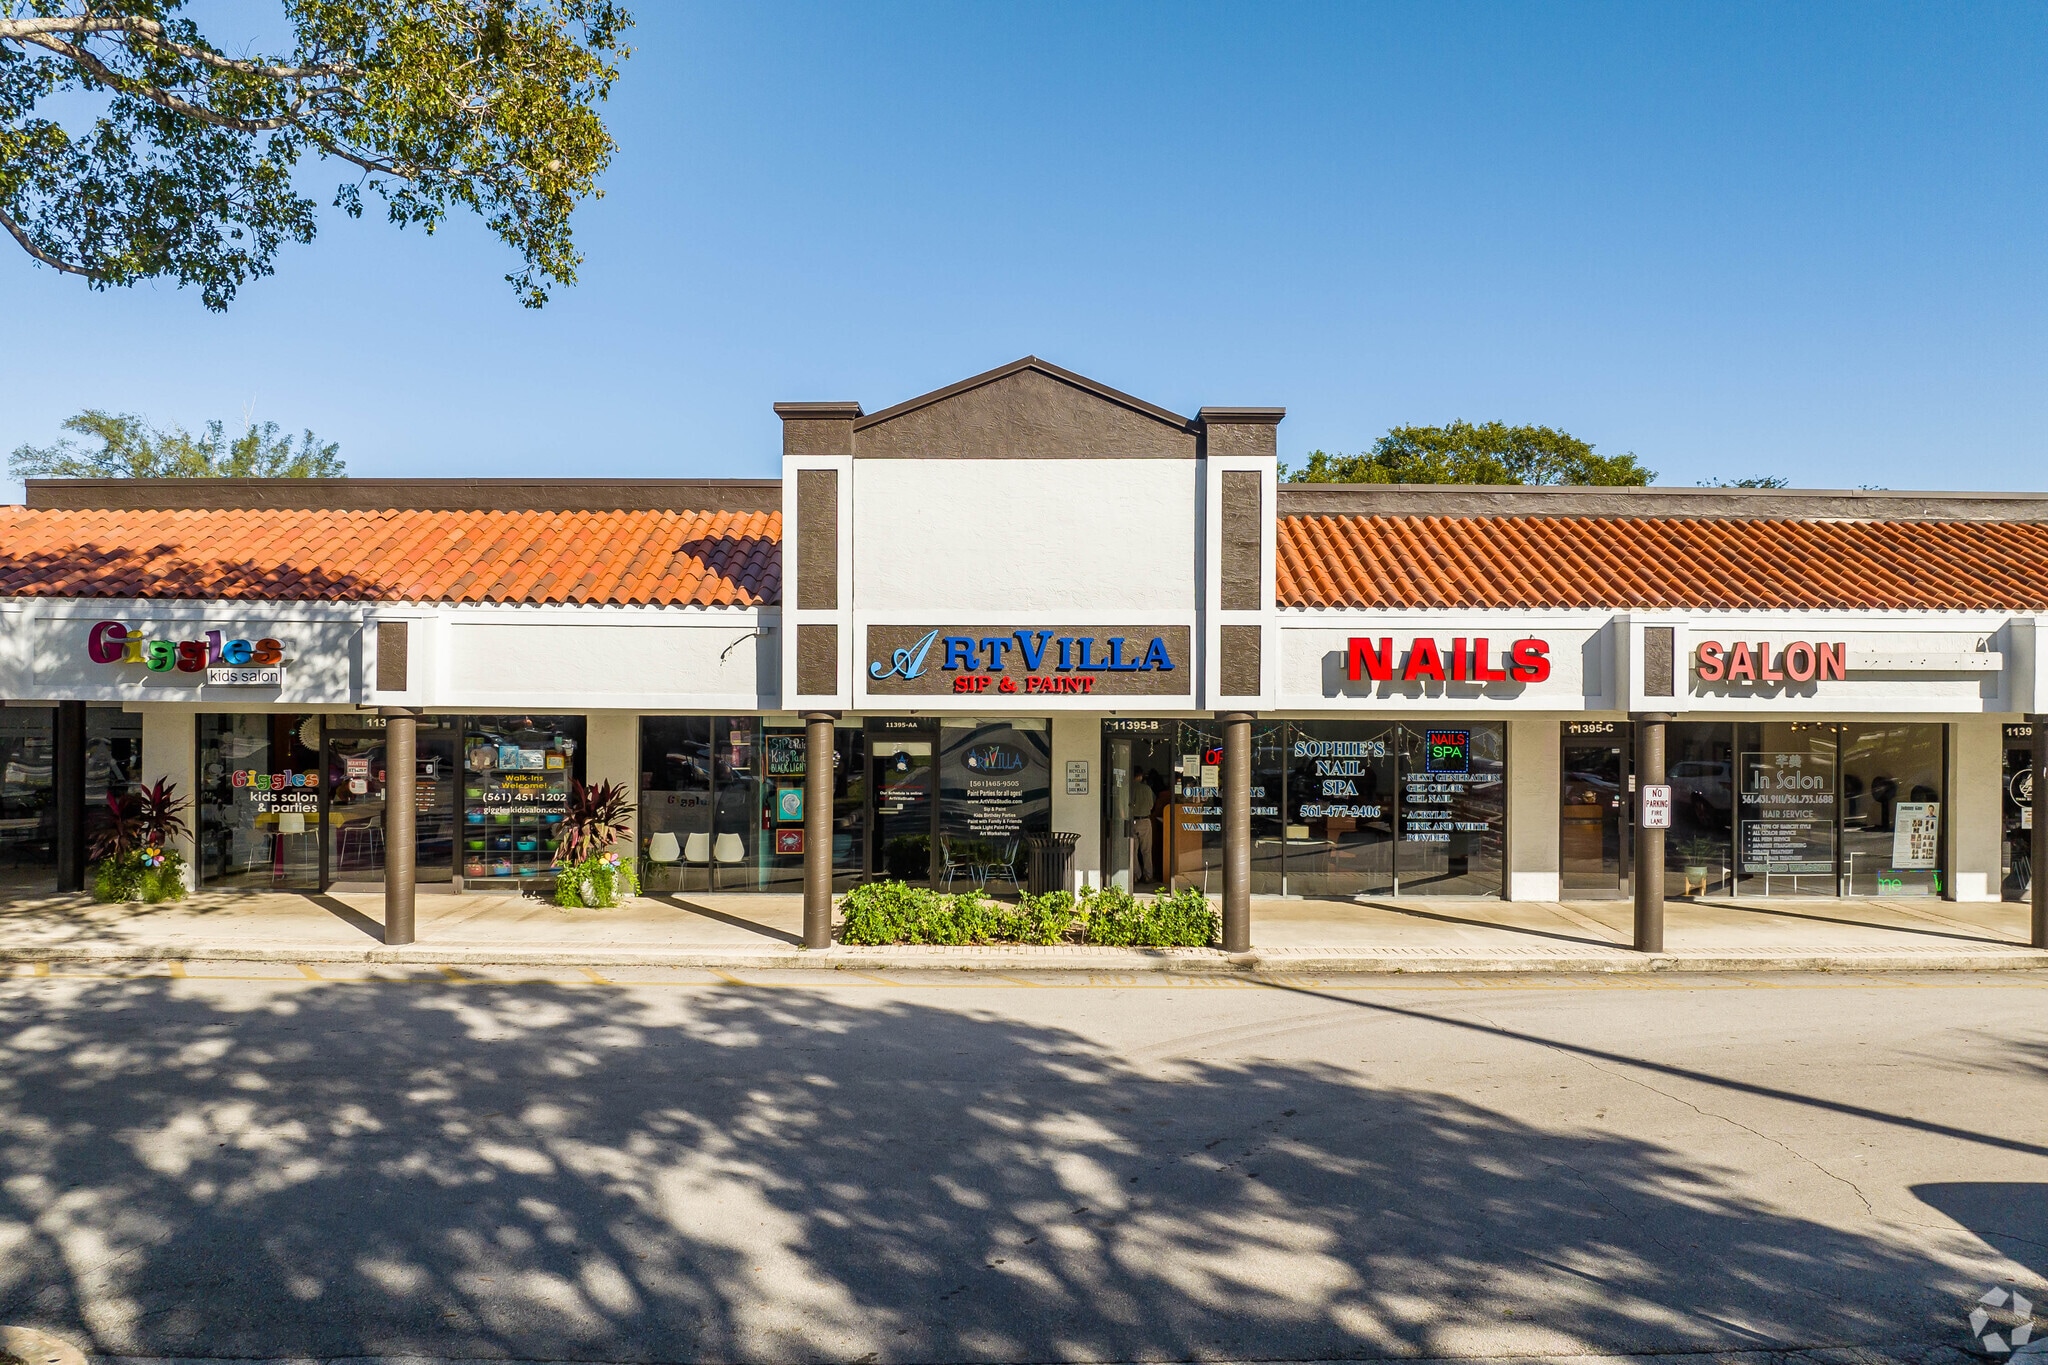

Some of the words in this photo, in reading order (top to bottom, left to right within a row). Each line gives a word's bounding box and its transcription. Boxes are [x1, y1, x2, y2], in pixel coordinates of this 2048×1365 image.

[88, 620, 285, 673] Giggles
[1347, 637, 1551, 683] NAILS
[1695, 640, 1846, 682] SALON
[210, 669, 238, 682] kids
[241, 669, 279, 683] salon
[953, 675, 993, 694] SIP
[999, 675, 1019, 694] &
[1024, 675, 1096, 694] PAINT
[367, 718, 387, 727] 113
[1113, 721, 1159, 730] 11395-B
[1569, 724, 1614, 734] 11395-C
[2006, 727, 2032, 736] 1139
[1431, 734, 1465, 745] NAILS
[1433, 746, 1463, 758] SPA
[1315, 760, 1365, 776] NAIL
[231, 769, 319, 791] Giggles
[1436, 773, 1501, 782] GENERATION
[1755, 770, 1770, 789] In
[1776, 770, 1824, 789] Salon
[1183, 787, 1219, 797] OPEN
[1323, 780, 1359, 796] SPA
[1406, 784, 1427, 793] GEL
[1428, 784, 1465, 793] COLOR
[250, 791, 277, 802] kids
[281, 791, 318, 802] salon
[482, 792, 512, 803] (561)
[514, 793, 567, 801] 451-1202
[1428, 795, 1453, 803] NAIL
[257, 803, 267, 812] &
[271, 802, 318, 814] parties
[1300, 805, 1381, 817] 561-477-2406
[1762, 810, 1780, 818] HAIR
[1782, 810, 1813, 818] SERVICE
[1182, 823, 1221, 831] WAXING
[1407, 822, 1432, 831] PINK
[1433, 822, 1454, 831] AND
[1455, 822, 1490, 831] WHITE
[1407, 834, 1450, 842] POWDER
